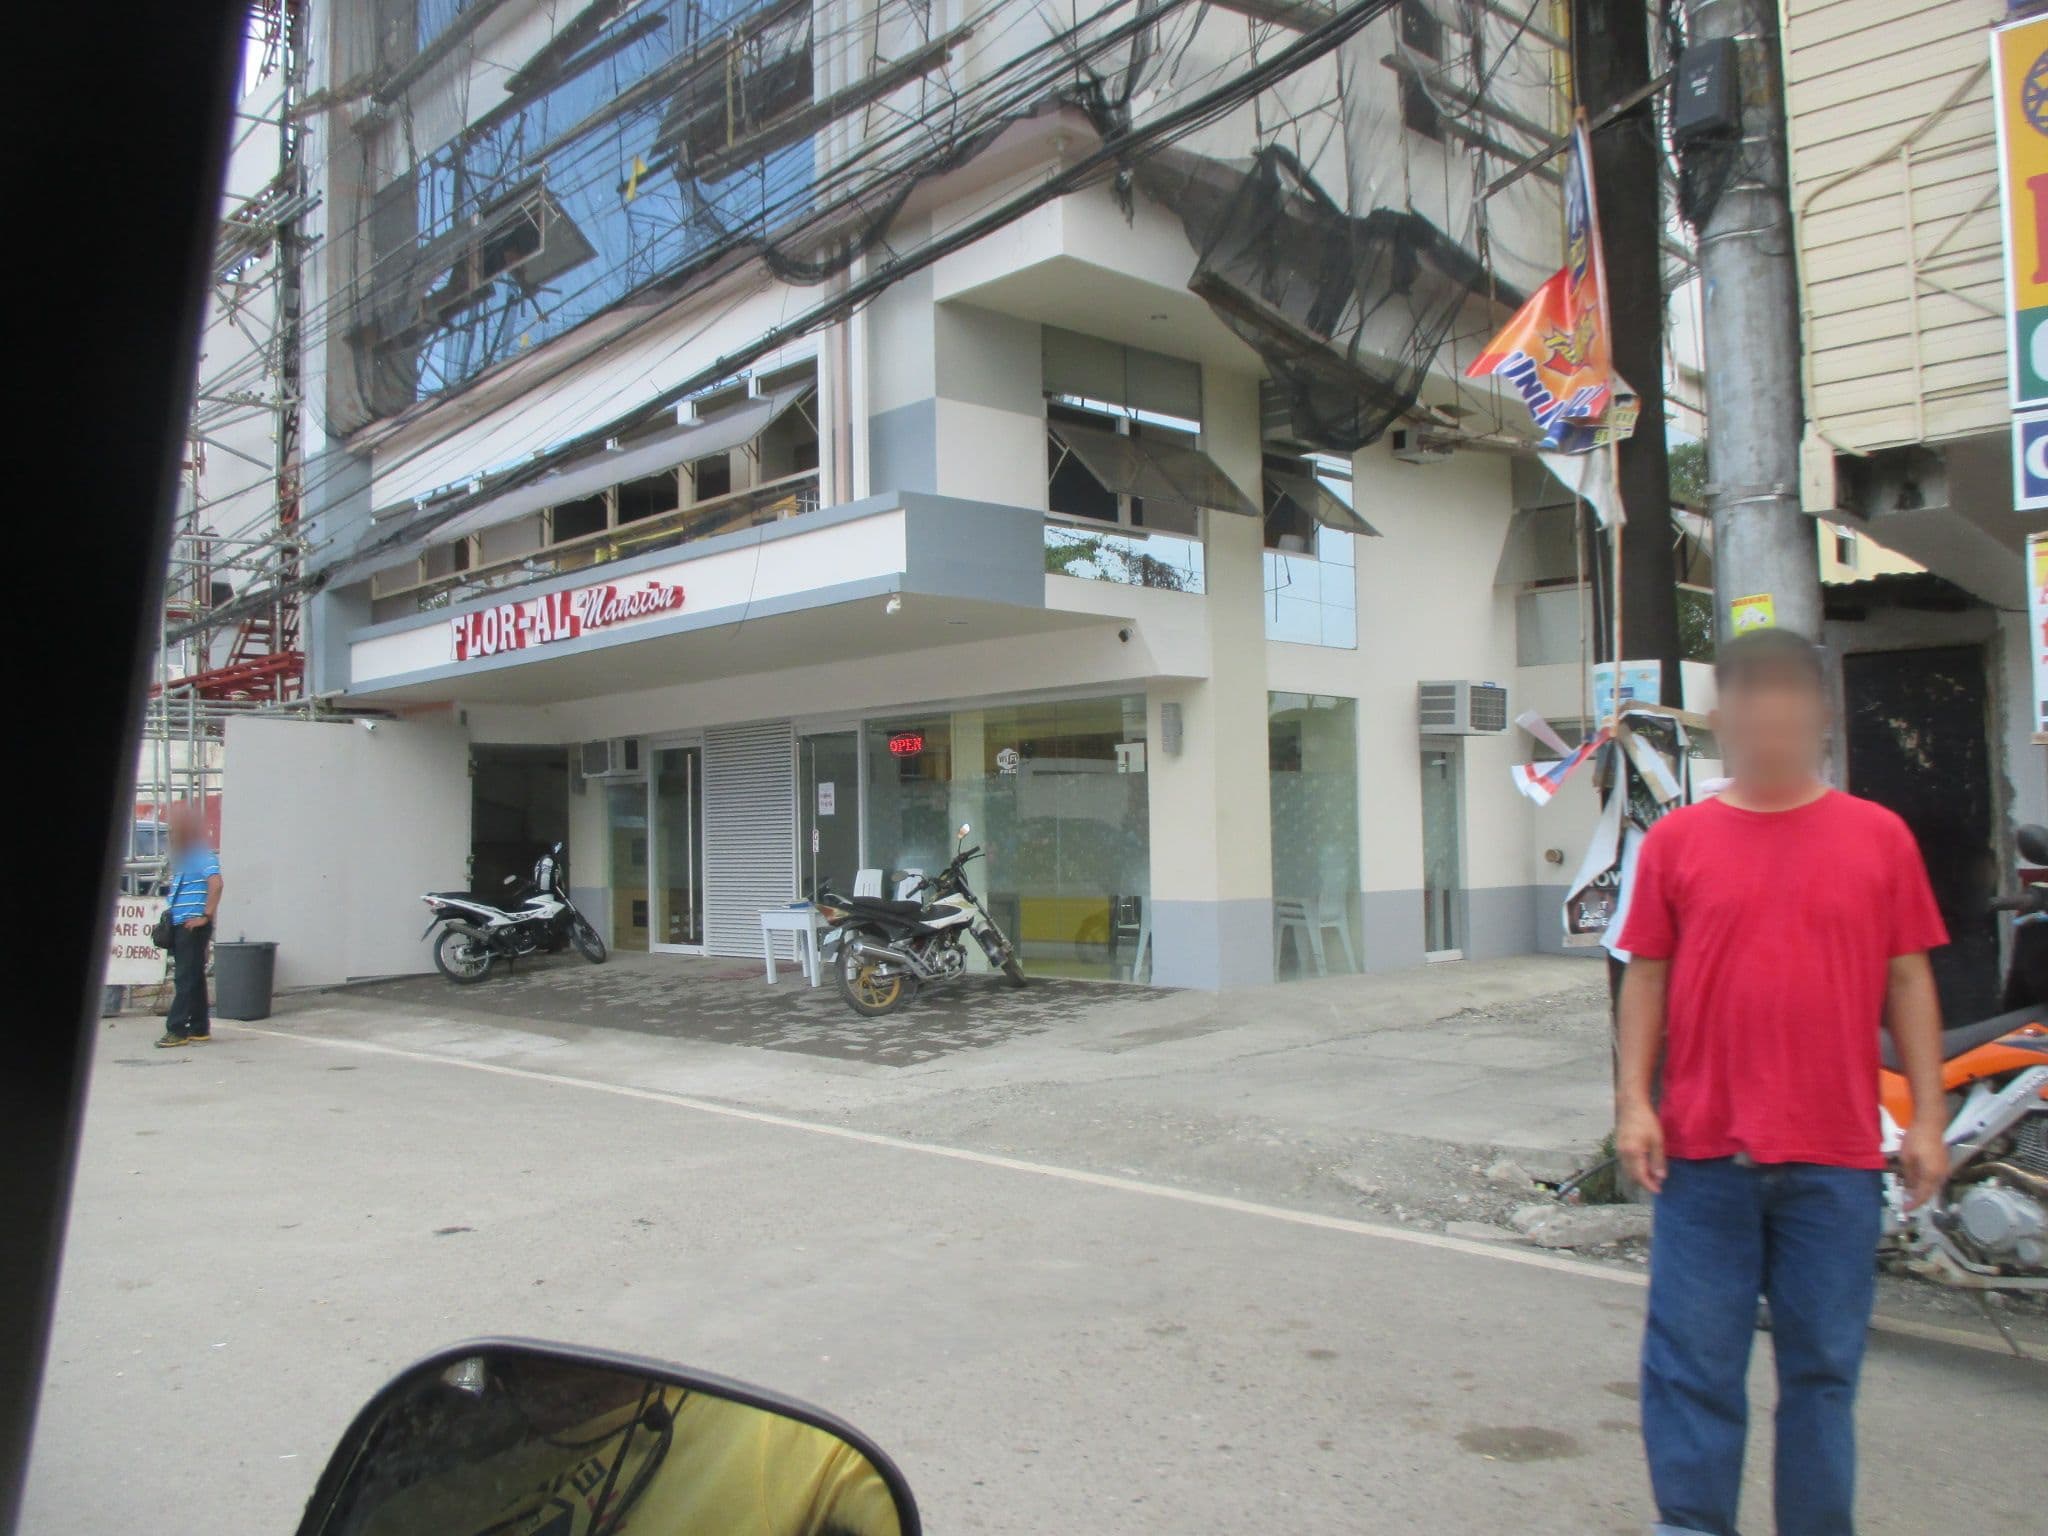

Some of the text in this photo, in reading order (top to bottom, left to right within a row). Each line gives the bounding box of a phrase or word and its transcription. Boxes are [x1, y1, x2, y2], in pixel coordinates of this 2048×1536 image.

[450, 582, 686, 660] FLOR-AL Mansion
[889, 736, 922, 752] OPEN
[113, 923, 138, 937] ARE
[126, 946, 161, 960] DEBRIS
